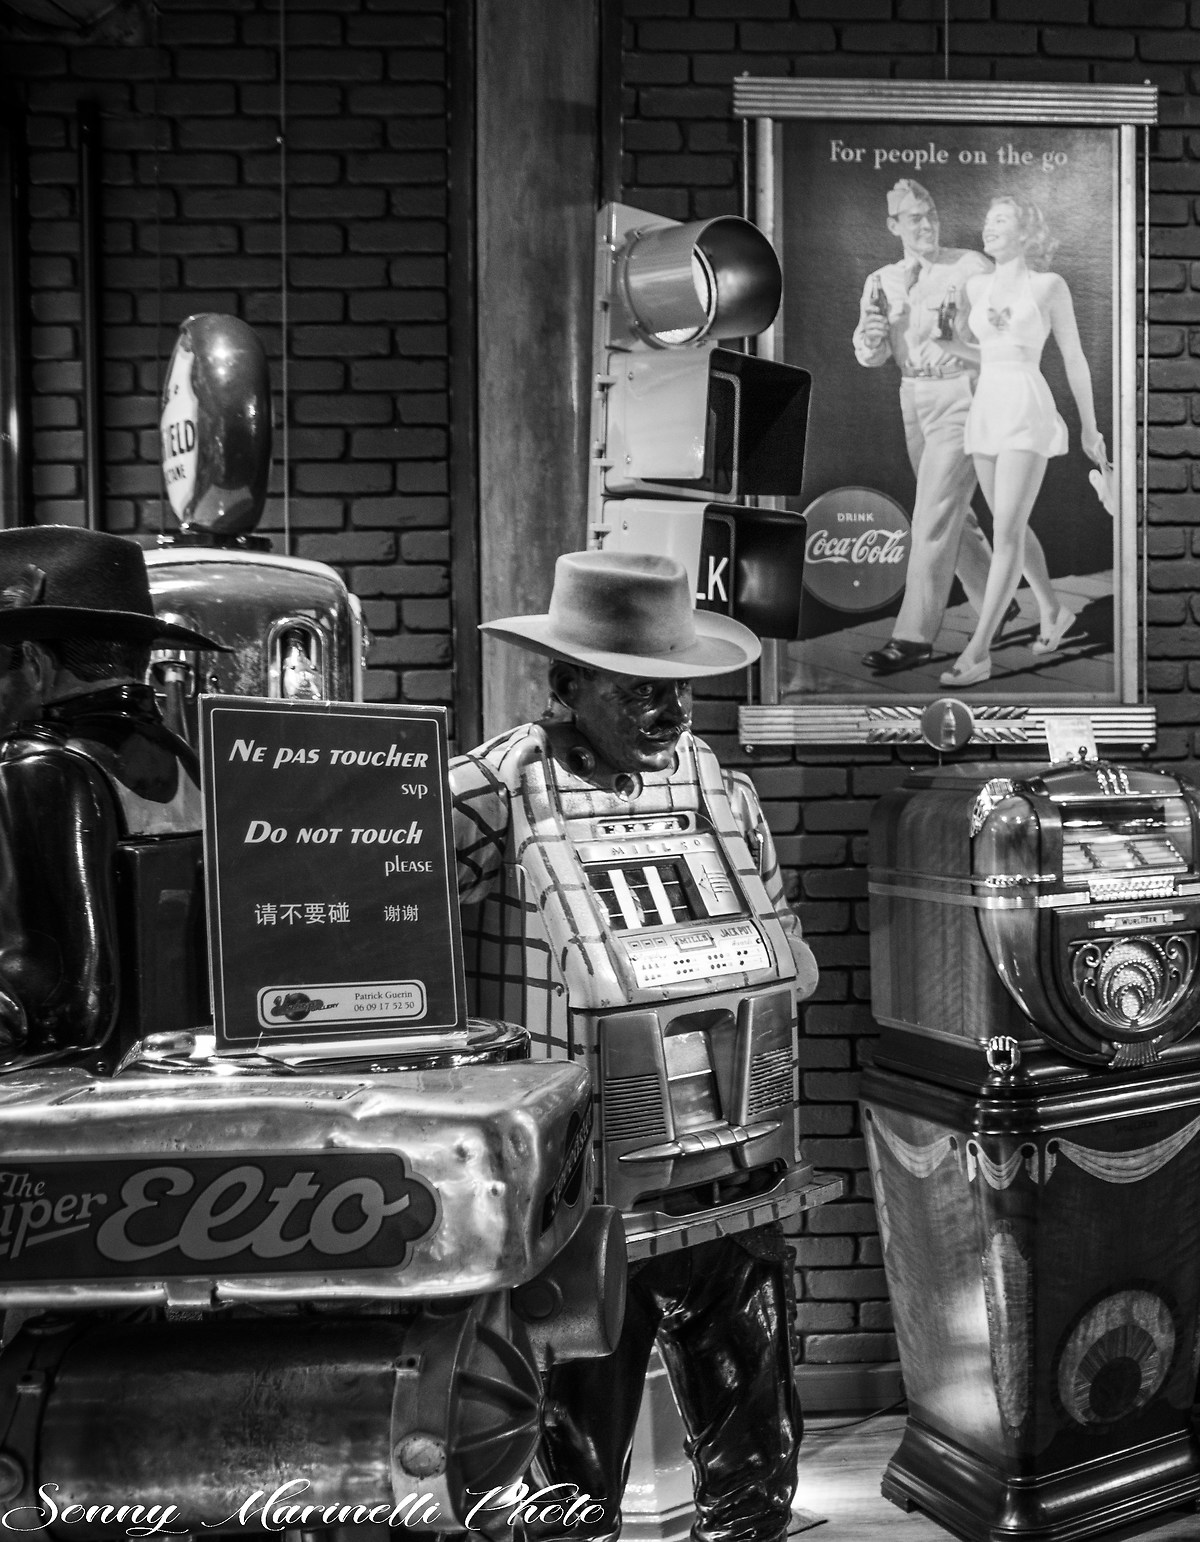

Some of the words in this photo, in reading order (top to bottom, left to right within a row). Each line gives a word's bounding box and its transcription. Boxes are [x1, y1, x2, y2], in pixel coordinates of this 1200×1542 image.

[829, 139, 866, 163] For
[873, 142, 950, 171] people
[957, 149, 987, 165] on
[996, 143, 1034, 166] the
[1041, 149, 1069, 173] go
[836, 512, 875, 523] DRINK
[804, 529, 909, 564] Coca-Cola
[400, 783, 429, 800] svp
[254, 901, 351, 926] 请不要碰
[383, 904, 420, 922] 谢谢
[1121, 916, 1158, 925] WURLITZER
[679, 933, 709, 945] MILLS
[353, 1003, 365, 1012] 06
[366, 1003, 377, 1012] 09
[380, 1001, 390, 1011] 17
[392, 1001, 403, 1010] 52
[405, 1000, 415, 1010] 50
[354, 991, 384, 1001] Patrick
[385, 990, 413, 1000] Guerin
[0, 1171, 46, 1198] The
[96, 1165, 411, 1262] Elto
[0, 1192, 108, 1259] per
